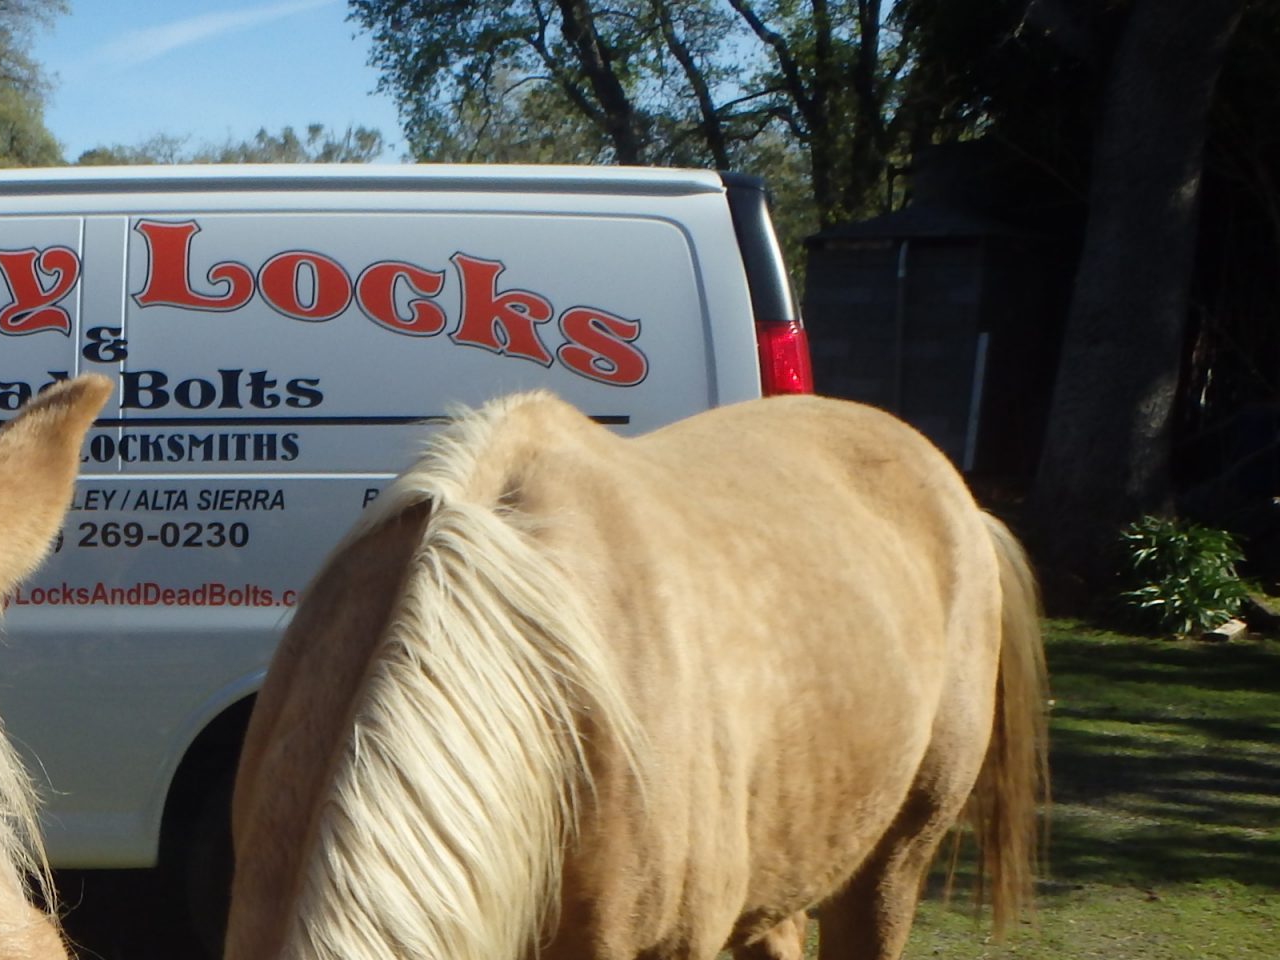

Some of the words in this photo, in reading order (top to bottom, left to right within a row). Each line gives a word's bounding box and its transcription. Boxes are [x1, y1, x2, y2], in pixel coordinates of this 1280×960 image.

[132, 218, 649, 388] Locks
[82, 326, 129, 364] &
[120, 368, 324, 410] Bolts
[133, 489, 188, 511] ALTA
[197, 488, 285, 511] SIERRA
[78, 521, 250, 548] 269-0230
[4, 582, 305, 608] LocksAndDeadBolts.c
